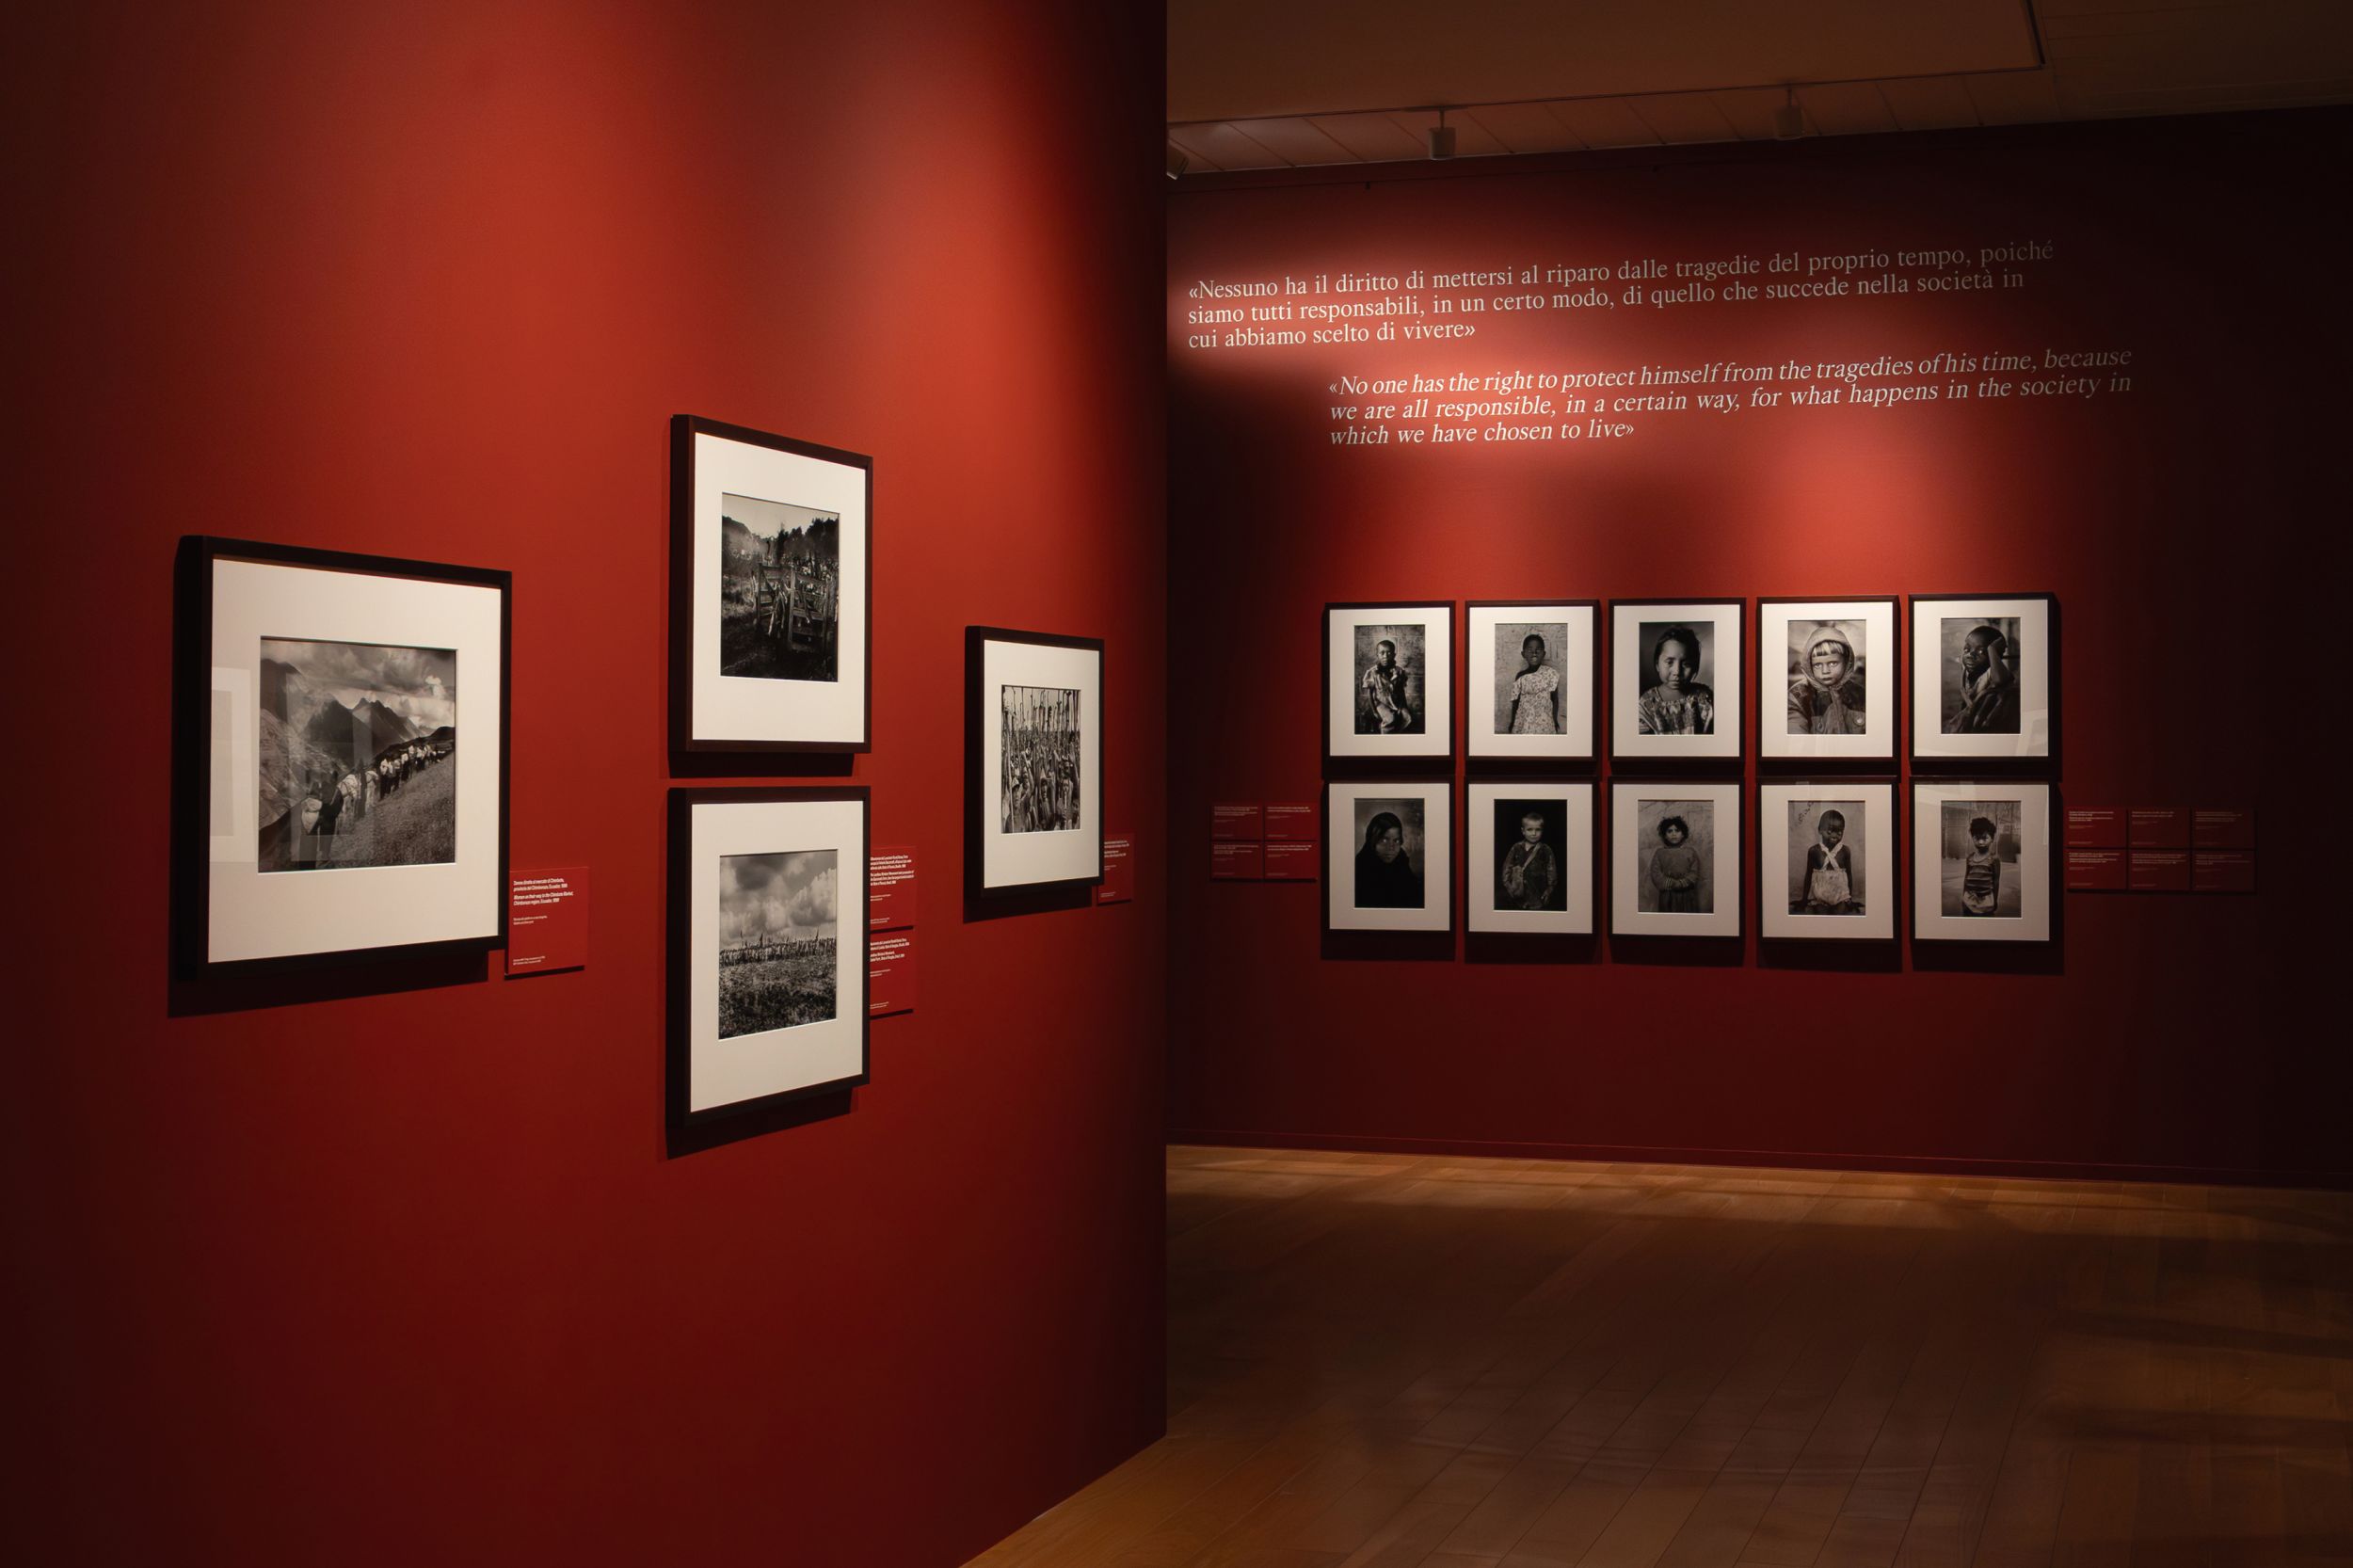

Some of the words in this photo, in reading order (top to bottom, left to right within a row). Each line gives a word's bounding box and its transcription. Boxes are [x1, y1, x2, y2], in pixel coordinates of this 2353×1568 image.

[1285, 276, 1307, 295] ha
[1315, 274, 1328, 294] il
[1336, 272, 1399, 293] diritto
[1405, 270, 1424, 290] di
[1432, 265, 1513, 288] mettersi
[1521, 264, 1538, 284] al
[1546, 264, 1610, 288] riparo
[1617, 259, 1668, 280] dalle
[1675, 254, 1761, 281] tragedie
[1769, 251, 1800, 273] del
[1808, 248, 1890, 276] proprio
[1897, 249, 1971, 273] tempo,
[1980, 239, 2054, 268] poiché
[1188, 305, 1244, 325] siamo
[1251, 300, 1292, 322] tutti
[1299, 295, 1425, 323] responsabili,
[1433, 295, 1453, 313] in
[1460, 297, 1485, 312] un
[1493, 294, 1545, 311] certo
[1552, 287, 1614, 310] modo,
[1623, 285, 1642, 305] di
[1651, 282, 1716, 309] quello
[1722, 280, 1758, 301] che
[1766, 276, 1849, 299] succede
[1857, 273, 1909, 295] nella
[1917, 268, 1993, 293] società
[2003, 267, 2024, 288] in
[1188, 328, 1217, 348] cui
[1225, 327, 1306, 347] abbiamo
[1313, 323, 1369, 344] scelto
[1376, 321, 1395, 341] di
[1371, 379, 1408, 394] one
[1411, 373, 1445, 393] has
[1449, 372, 1481, 392] the
[1482, 370, 1535, 396] right
[1538, 373, 1558, 389] to
[1560, 370, 1637, 393] protect
[1640, 361, 1722, 385] himself
[1721, 361, 1773, 384] from
[1779, 360, 1812, 380] the
[1817, 356, 1913, 383] tragedies
[1918, 353, 1944, 375] of
[1945, 352, 1977, 374] his
[1982, 350, 2037, 373] time,
[2044, 348, 2132, 369] because
[1331, 406, 1357, 420] we
[1364, 405, 1396, 420] are
[1401, 398, 1429, 419] all
[1434, 394, 1556, 422] responsible,
[1565, 393, 1586, 413] in
[1593, 398, 1605, 413] a
[1613, 391, 1688, 412] certain
[1697, 393, 1740, 416] way,
[1750, 386, 1783, 408] for
[1790, 384, 1842, 406] what
[1849, 383, 1939, 408] happens
[1946, 378, 1969, 399] in
[1978, 376, 2012, 398] the
[2019, 374, 2102, 399] society
[2109, 372, 2131, 392] in
[1330, 424, 1389, 445] which
[1398, 429, 1425, 443] we
[1431, 423, 1478, 443] have
[1483, 421, 1553, 441] chosen
[1561, 423, 1581, 440] to
